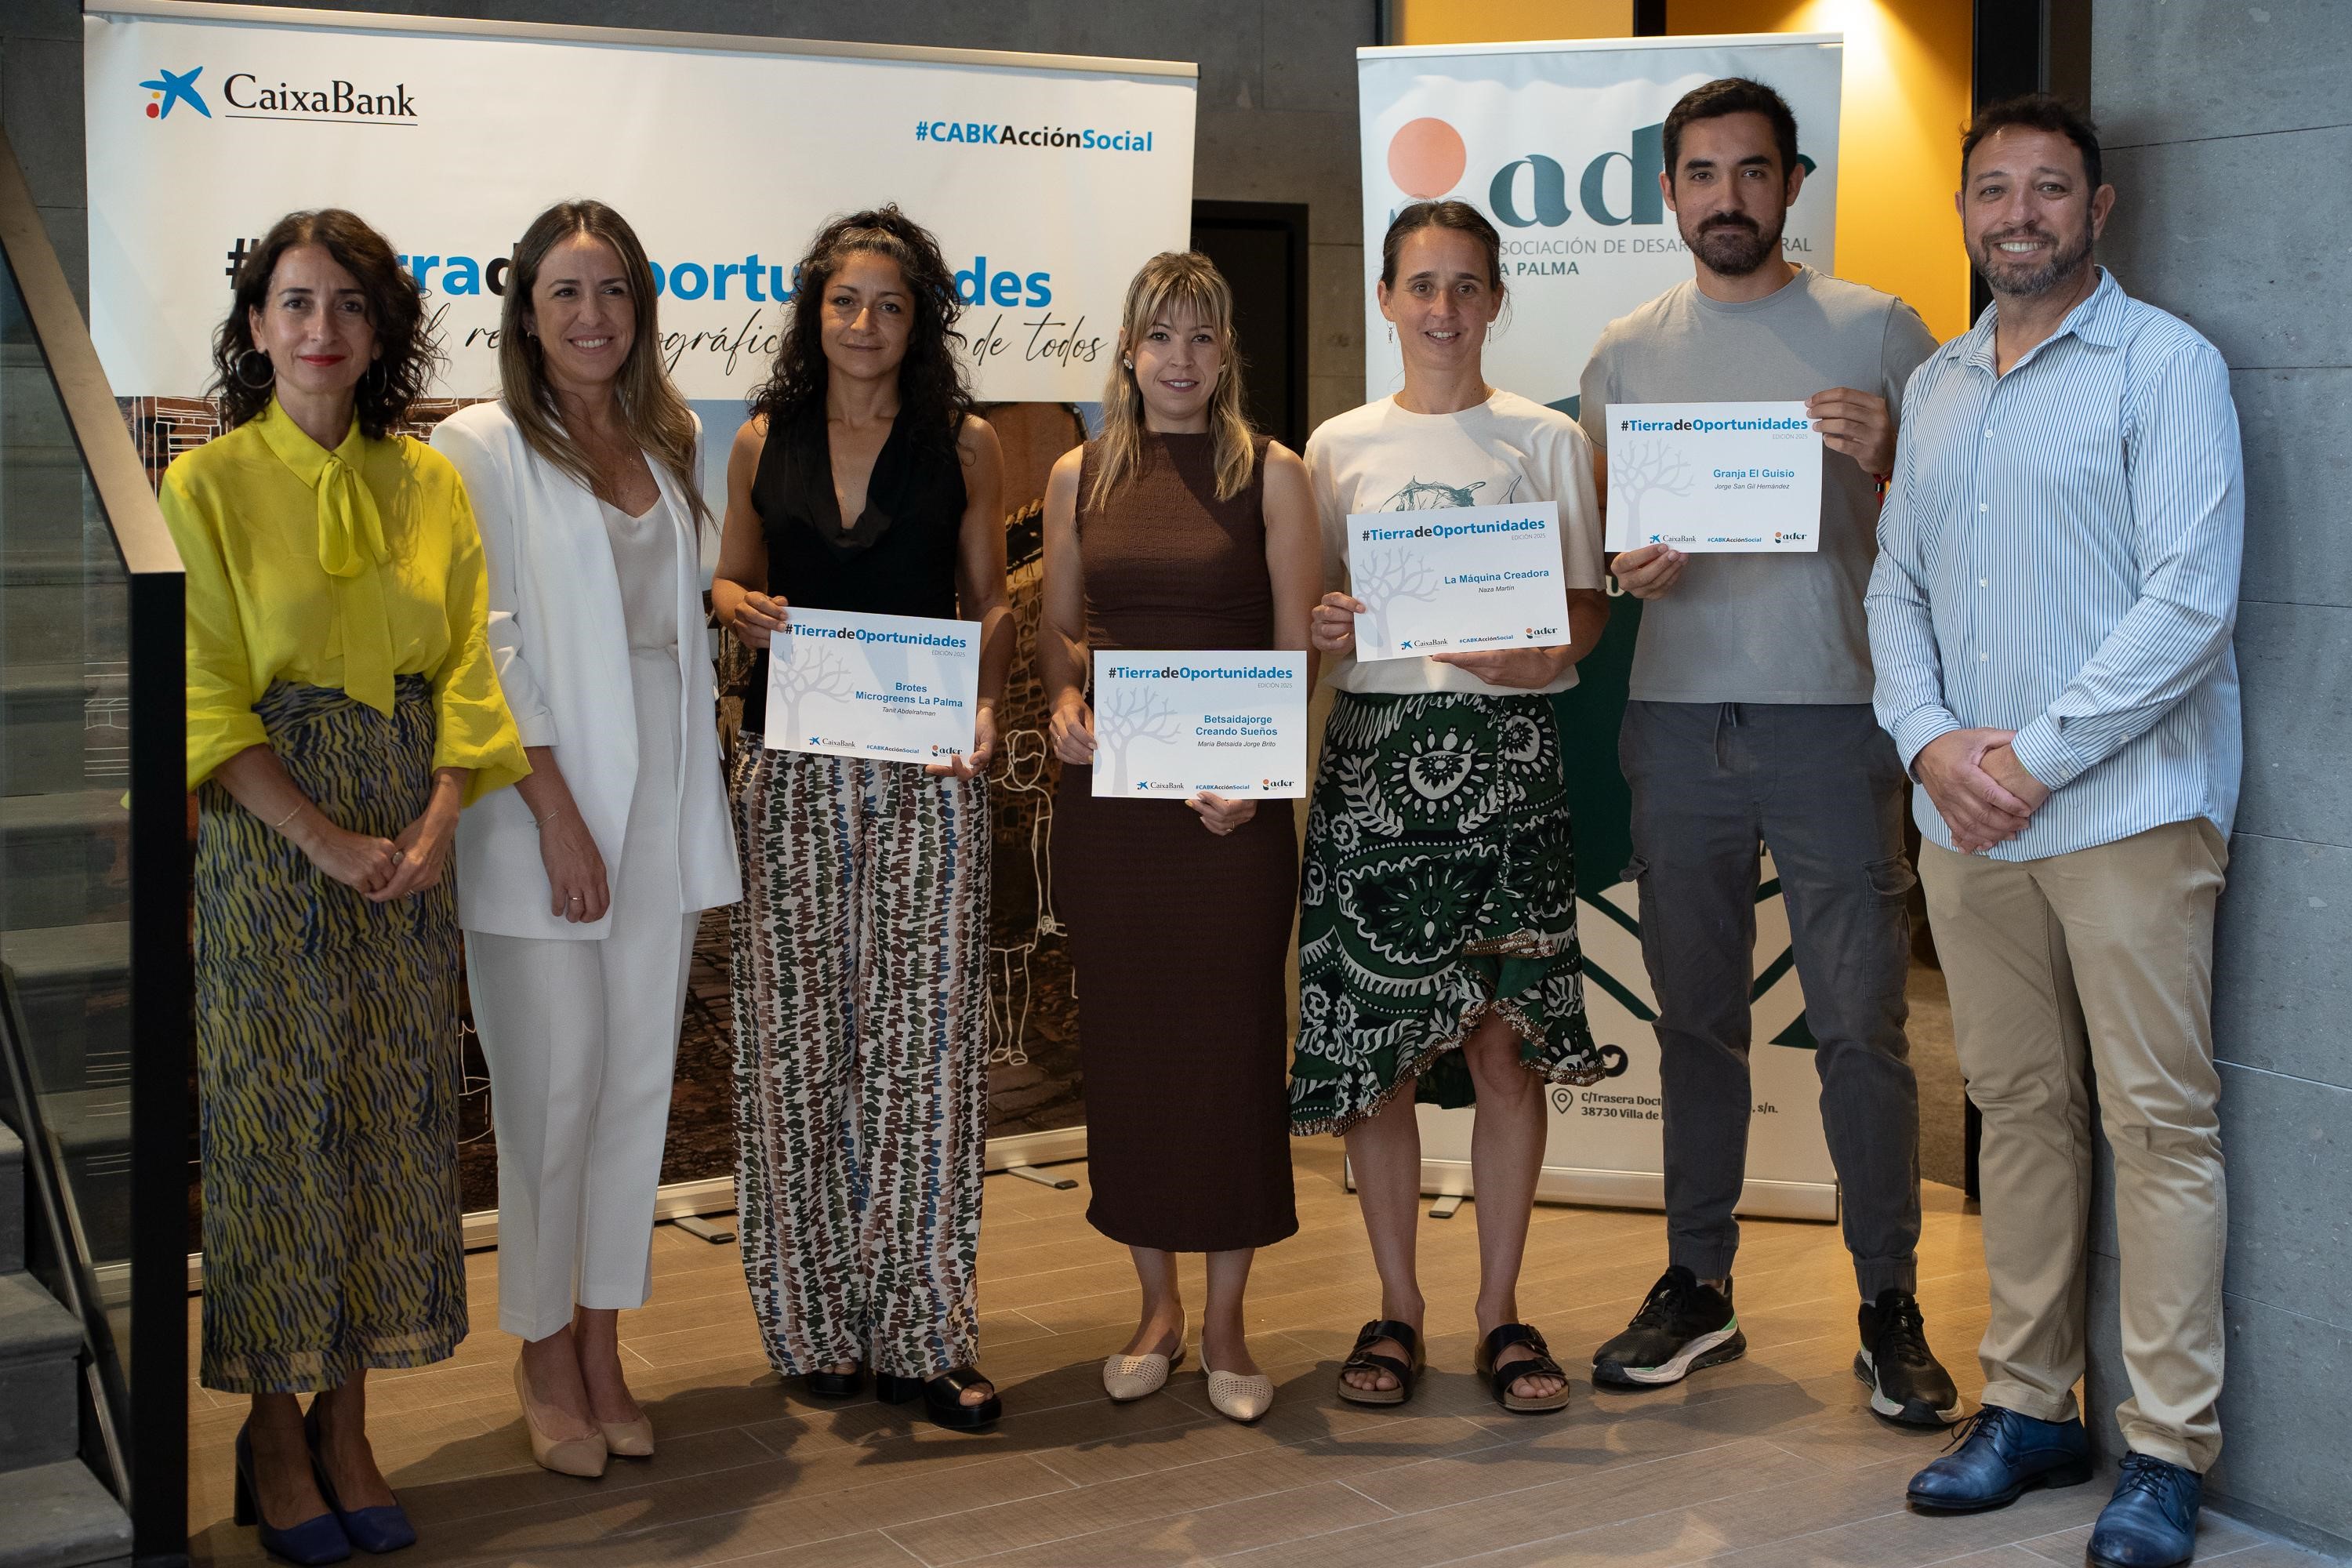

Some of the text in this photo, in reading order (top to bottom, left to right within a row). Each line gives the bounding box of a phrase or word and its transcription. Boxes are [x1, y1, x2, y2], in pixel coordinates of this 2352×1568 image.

[224, 73, 418, 117] CaixaBank
[916, 122, 1152, 152] #CABKAcciónSocial
[1501, 237, 1595, 255] SOCIACIÓN
[1603, 239, 1626, 253] DE
[1781, 238, 1812, 252] RAL
[1500, 261, 1580, 276] A PALMA
[973, 314, 1012, 366] de
[1023, 312, 1108, 367] todos
[1621, 418, 1808, 433] #TierradeOportunidades
[1713, 470, 1746, 480] Granja
[1762, 469, 1795, 478] Guisio
[1362, 518, 1545, 542] #TierradeOportunidades
[1459, 573, 1501, 585] Máquina
[1504, 570, 1549, 580] Creadora
[785, 624, 967, 648] #TierradeOportunidades
[1414, 638, 1448, 648] CaixaBank
[1460, 634, 1514, 644] #CABKAcciónSocial
[1109, 666, 1293, 681] #TierradeOportunidades
[895, 682, 927, 693] Brotes
[855, 691, 963, 707] Microgreens La Palma
[1204, 715, 1272, 726] Betsaidajorge
[1240, 726, 1277, 735] Sueños
[822, 738, 855, 747] CaixaBank
[866, 745, 920, 753] #CABKAcciónSocial
[1581, 1092, 1635, 1104] C/Trasera
[1758, 1102, 1778, 1114] s/n.
[1581, 1106, 1659, 1120] 38730 Villa de
